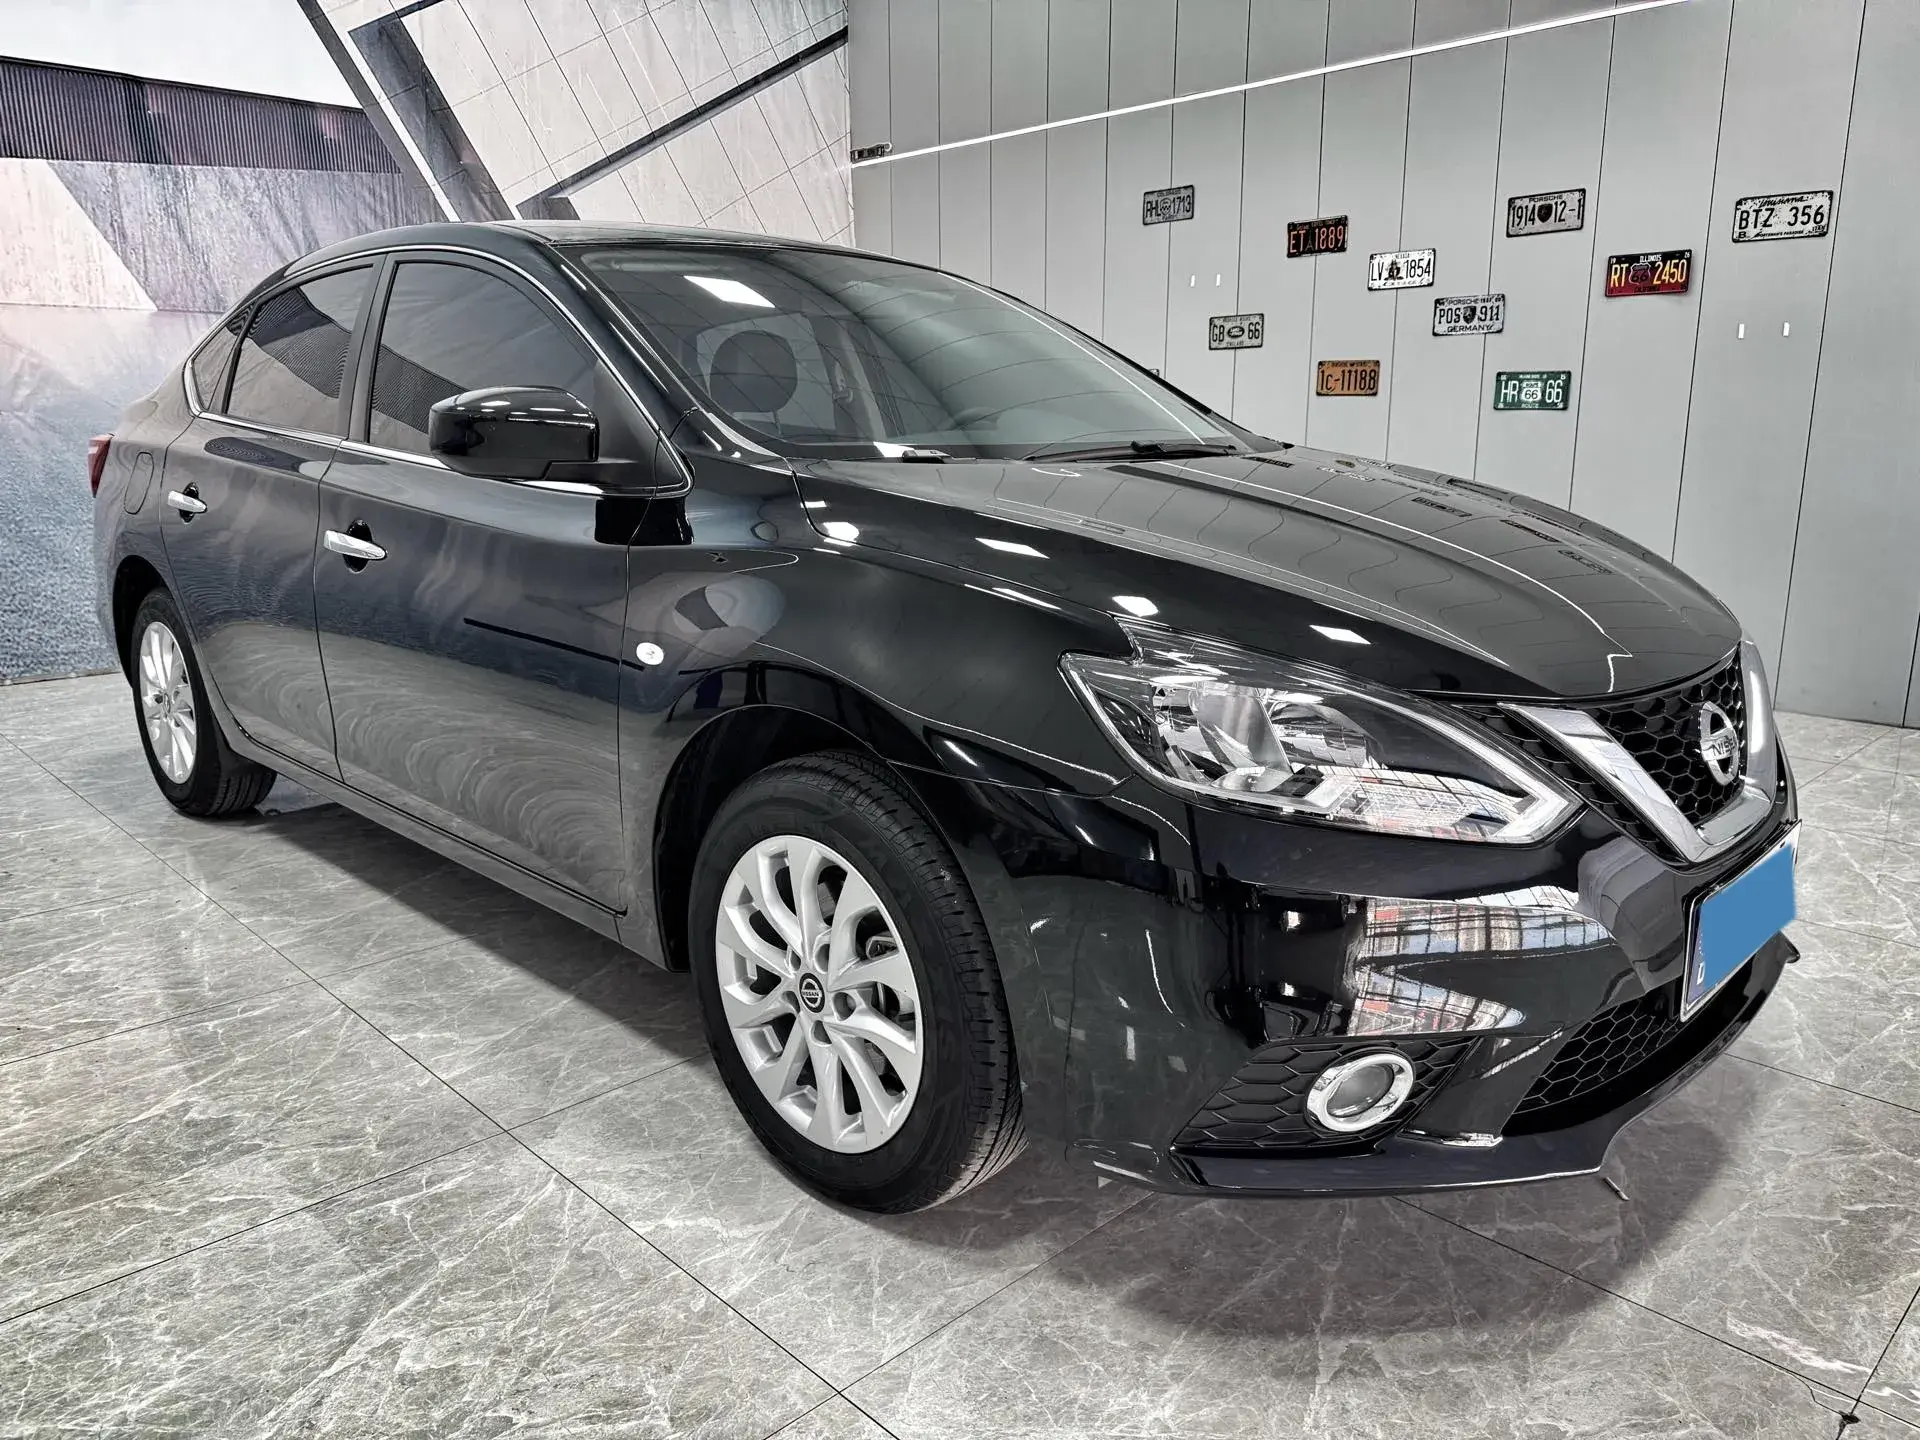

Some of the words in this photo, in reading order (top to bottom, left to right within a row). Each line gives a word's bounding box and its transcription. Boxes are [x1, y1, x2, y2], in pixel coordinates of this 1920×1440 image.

[1172, 194, 1191, 214] 1713
[1529, 194, 1563, 203] PORSCHE
[1511, 204, 1536, 228] 1914
[1554, 197, 1582, 223] 12-1
[1738, 207, 1775, 230] BTZ
[1787, 204, 1824, 227] 356
[1290, 230, 1306, 253] ET
[1315, 225, 1344, 250] 1889
[1371, 261, 1384, 281] LV
[1403, 257, 1431, 279] 1854
[1640, 254, 1662, 263] ILLINOIS
[1610, 263, 1629, 288] RT
[1653, 258, 1688, 285] 2450
[1438, 307, 1461, 325] POS
[1480, 304, 1500, 322] 911
[1212, 324, 1225, 342] GB
[1247, 321, 1261, 340] 66
[1447, 324, 1494, 333] GERMANY
[1500, 380, 1519, 403] HR
[1545, 379, 1563, 404] 66
[1524, 389, 1539, 400] 66
